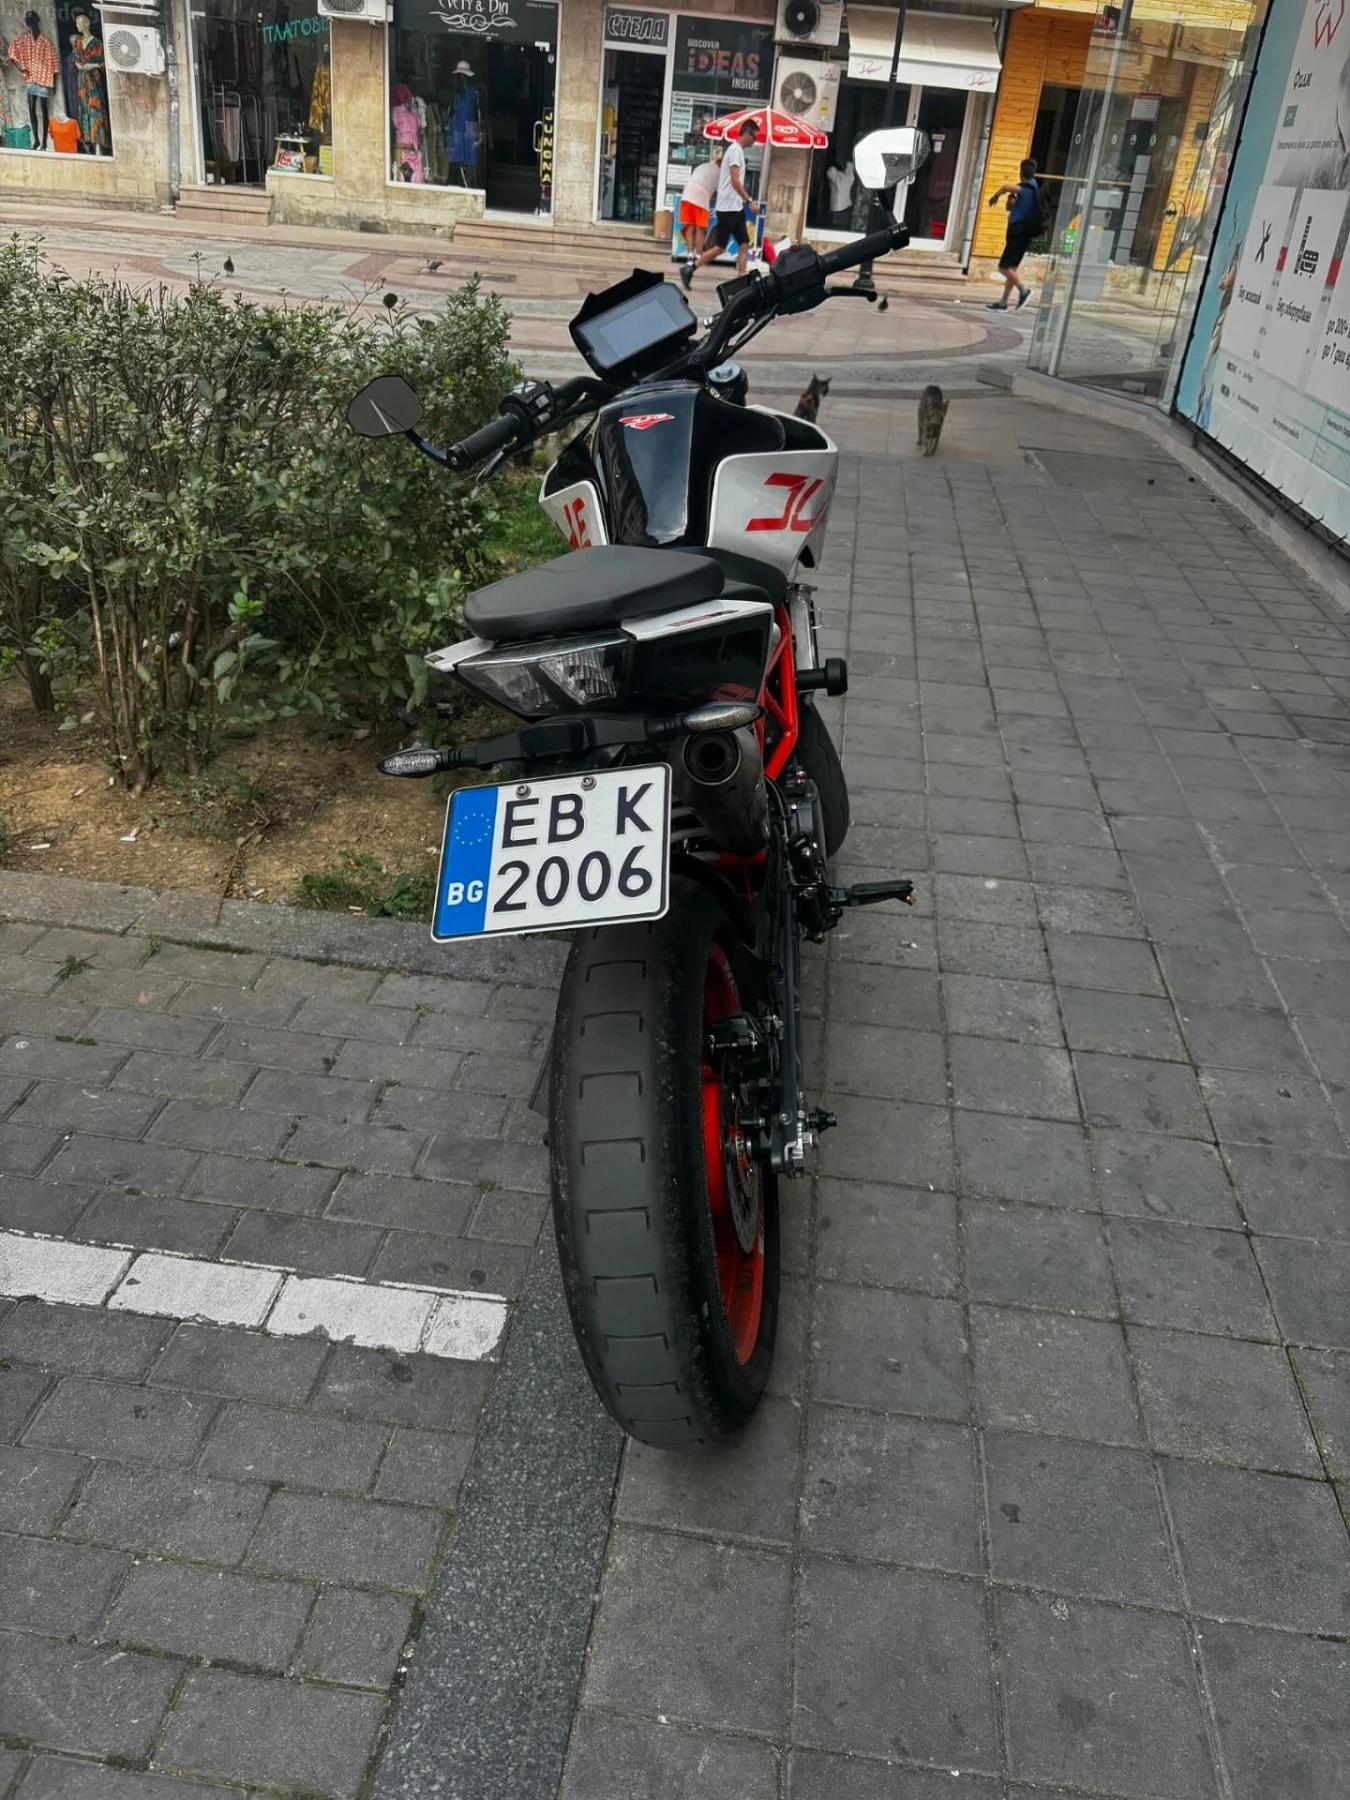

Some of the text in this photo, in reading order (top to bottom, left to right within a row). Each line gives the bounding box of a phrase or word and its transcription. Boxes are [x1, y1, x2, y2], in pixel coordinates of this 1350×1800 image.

[607, 14, 666, 41] СТЕЛА
[687, 38, 720, 49] DISCOVER
[732, 77, 760, 91] INSIDE
[542, 111, 553, 183] JUNONA
[502, 783, 654, 849] EB K
[493, 845, 653, 913] 2006
[447, 880, 484, 906] BG
